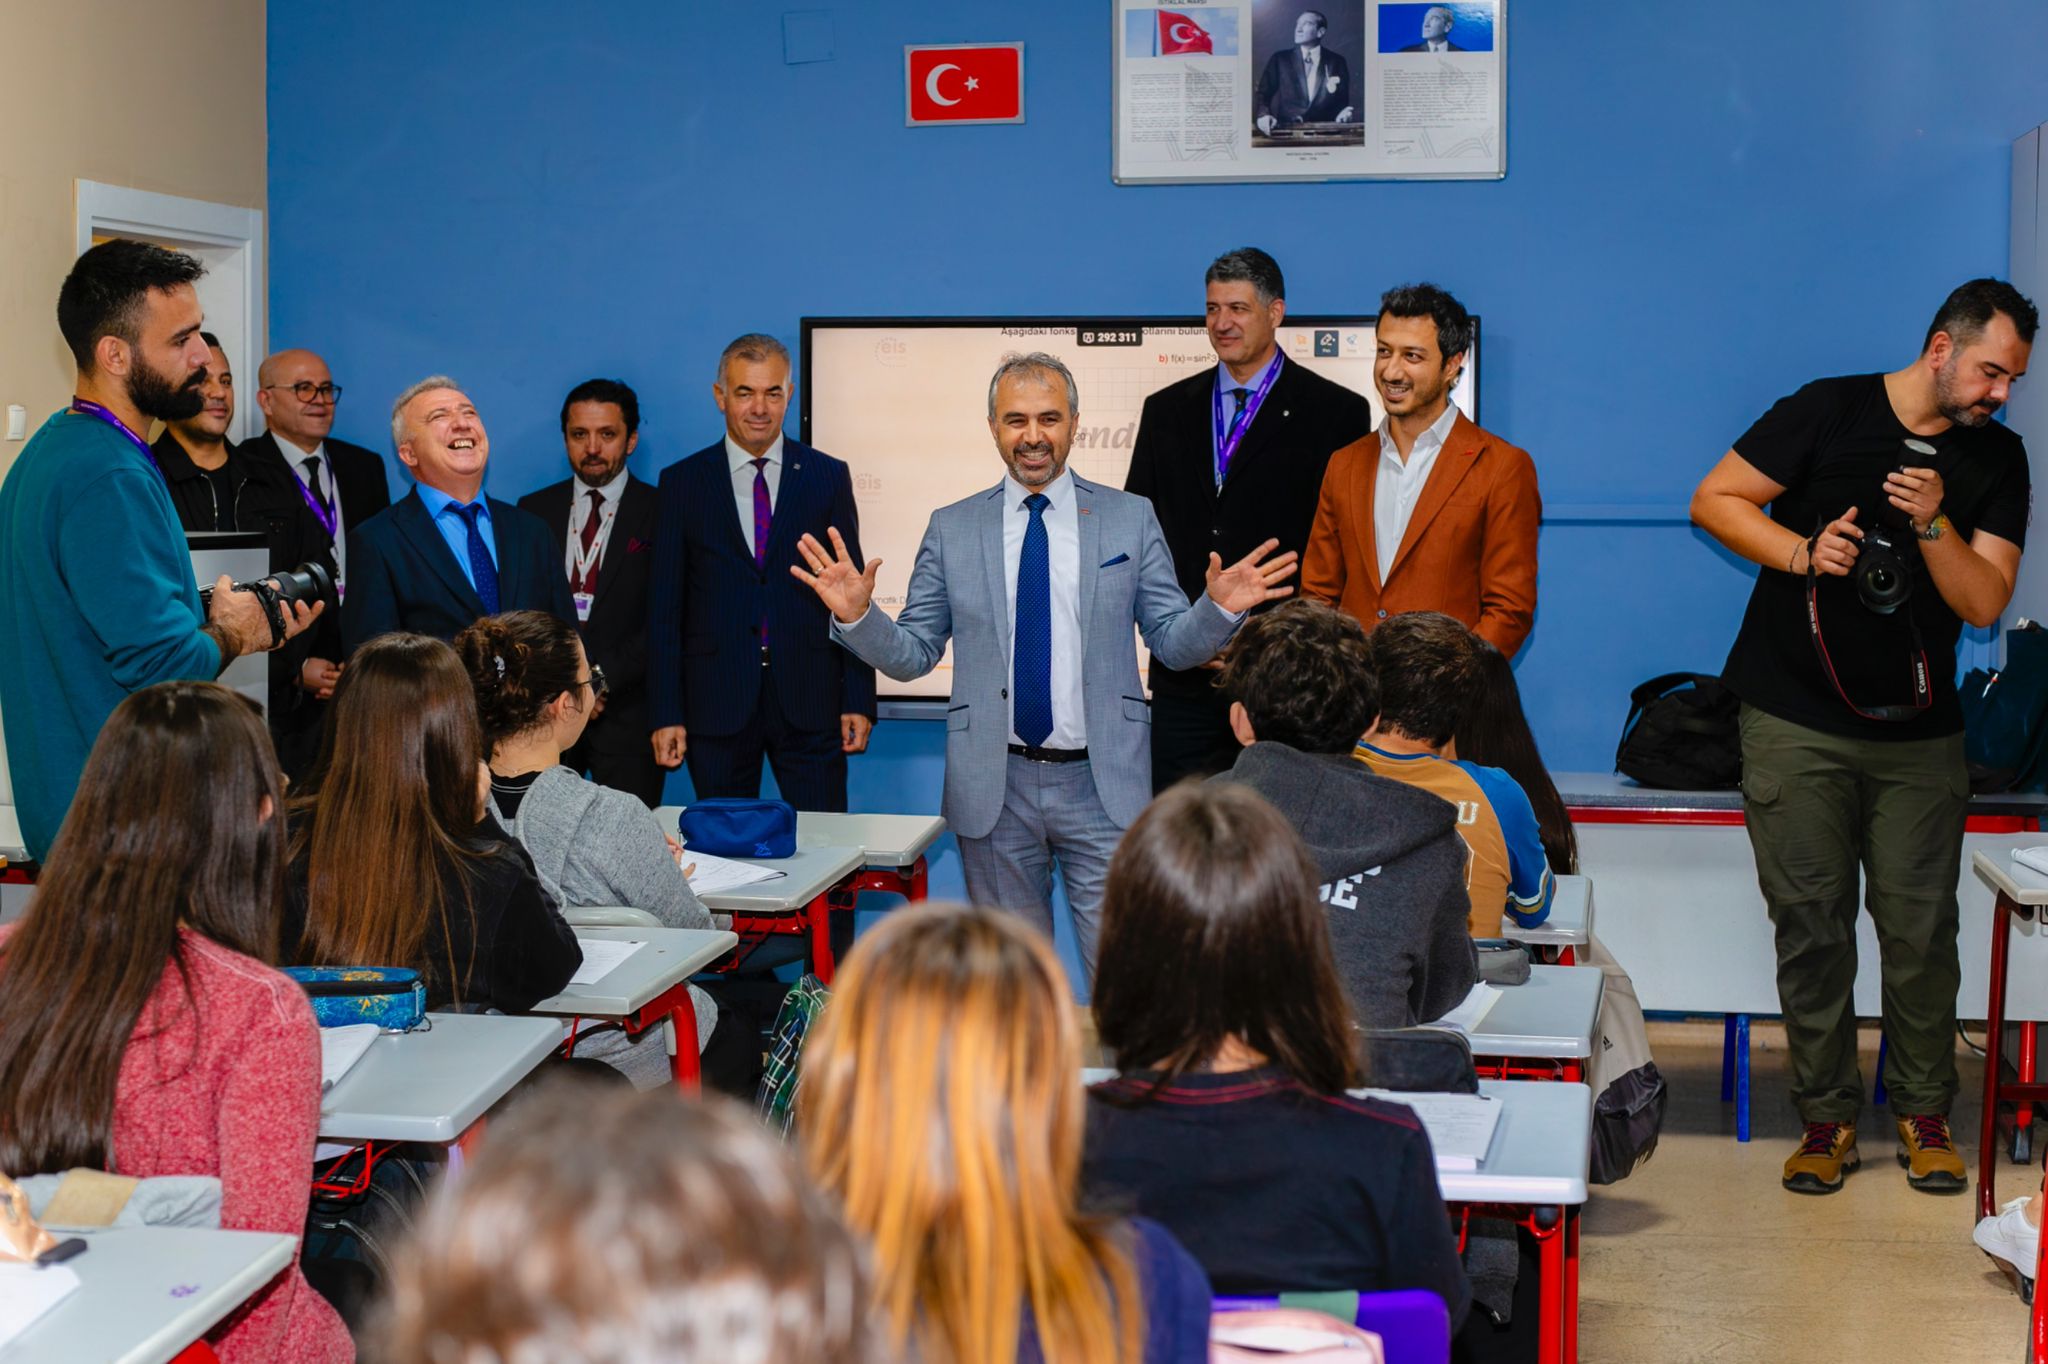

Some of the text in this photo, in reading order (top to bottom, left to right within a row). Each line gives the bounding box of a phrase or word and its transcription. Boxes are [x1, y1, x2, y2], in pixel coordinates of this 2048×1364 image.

[1097, 332, 1137, 342] 292 311
[1158, 354, 1168, 364] b)
[1917, 662, 1926, 693] Canon
